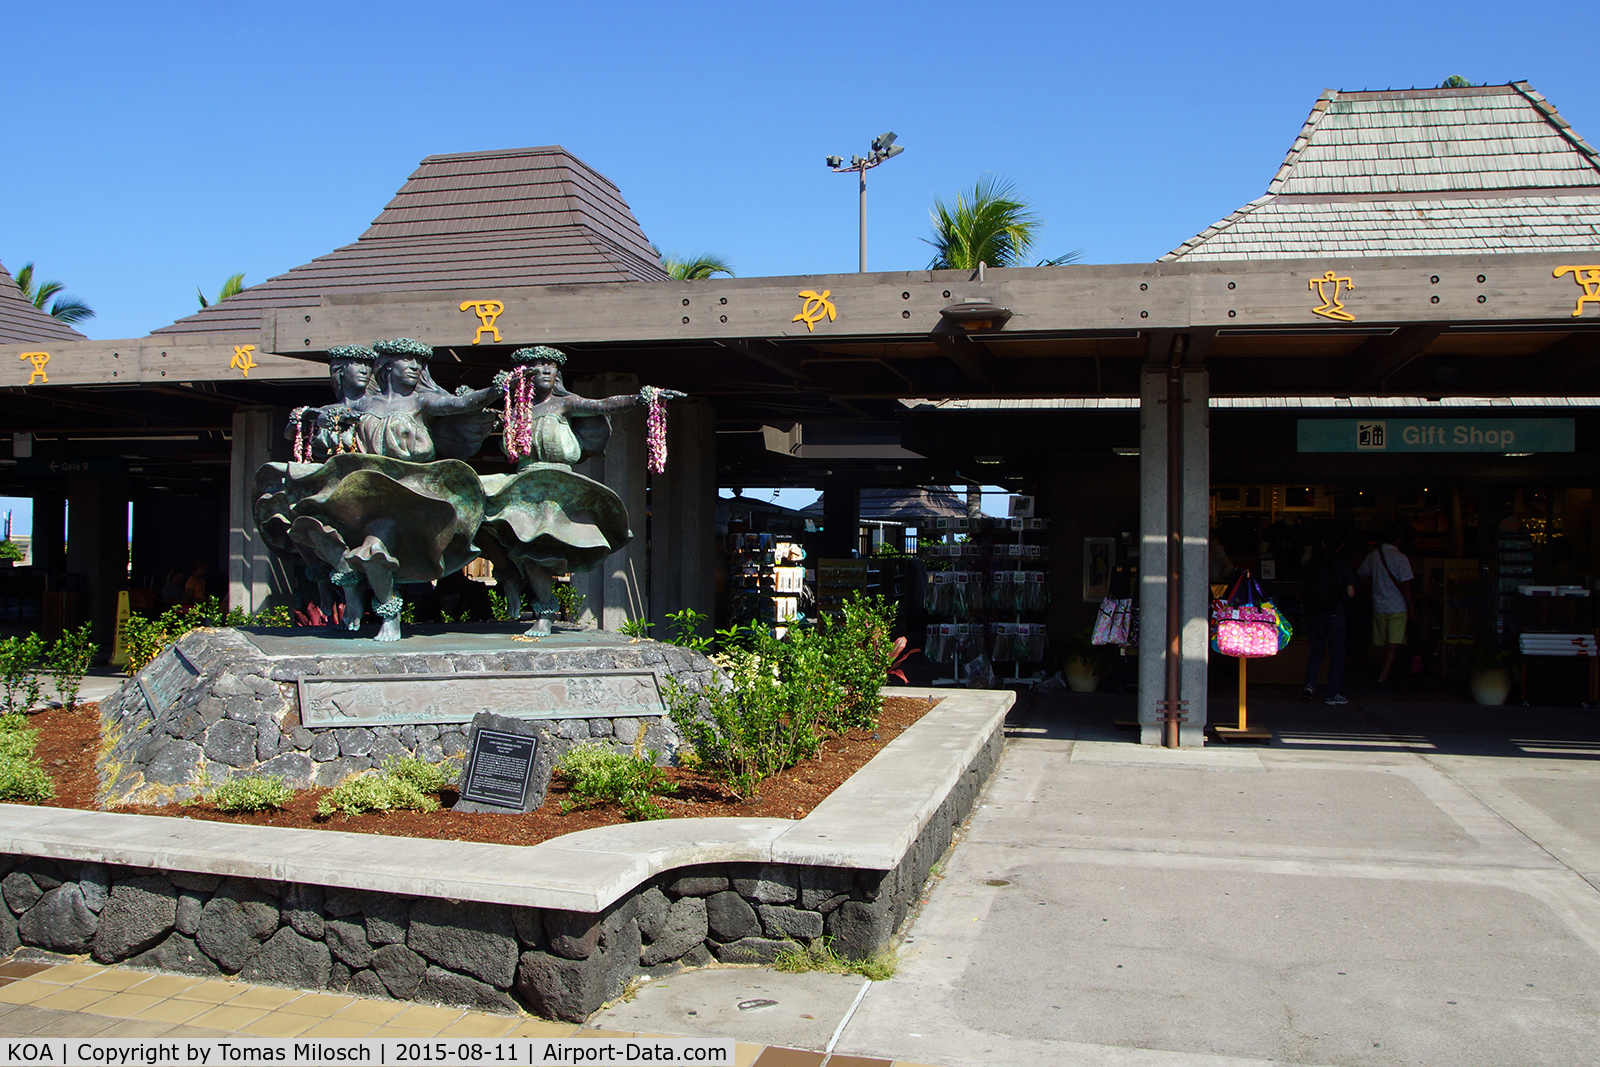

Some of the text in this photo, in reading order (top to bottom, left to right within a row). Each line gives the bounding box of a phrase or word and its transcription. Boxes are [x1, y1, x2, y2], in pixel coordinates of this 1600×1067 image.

[1402, 425, 1515, 449] Gift Shop
[60, 461, 89, 471] Gate 9
